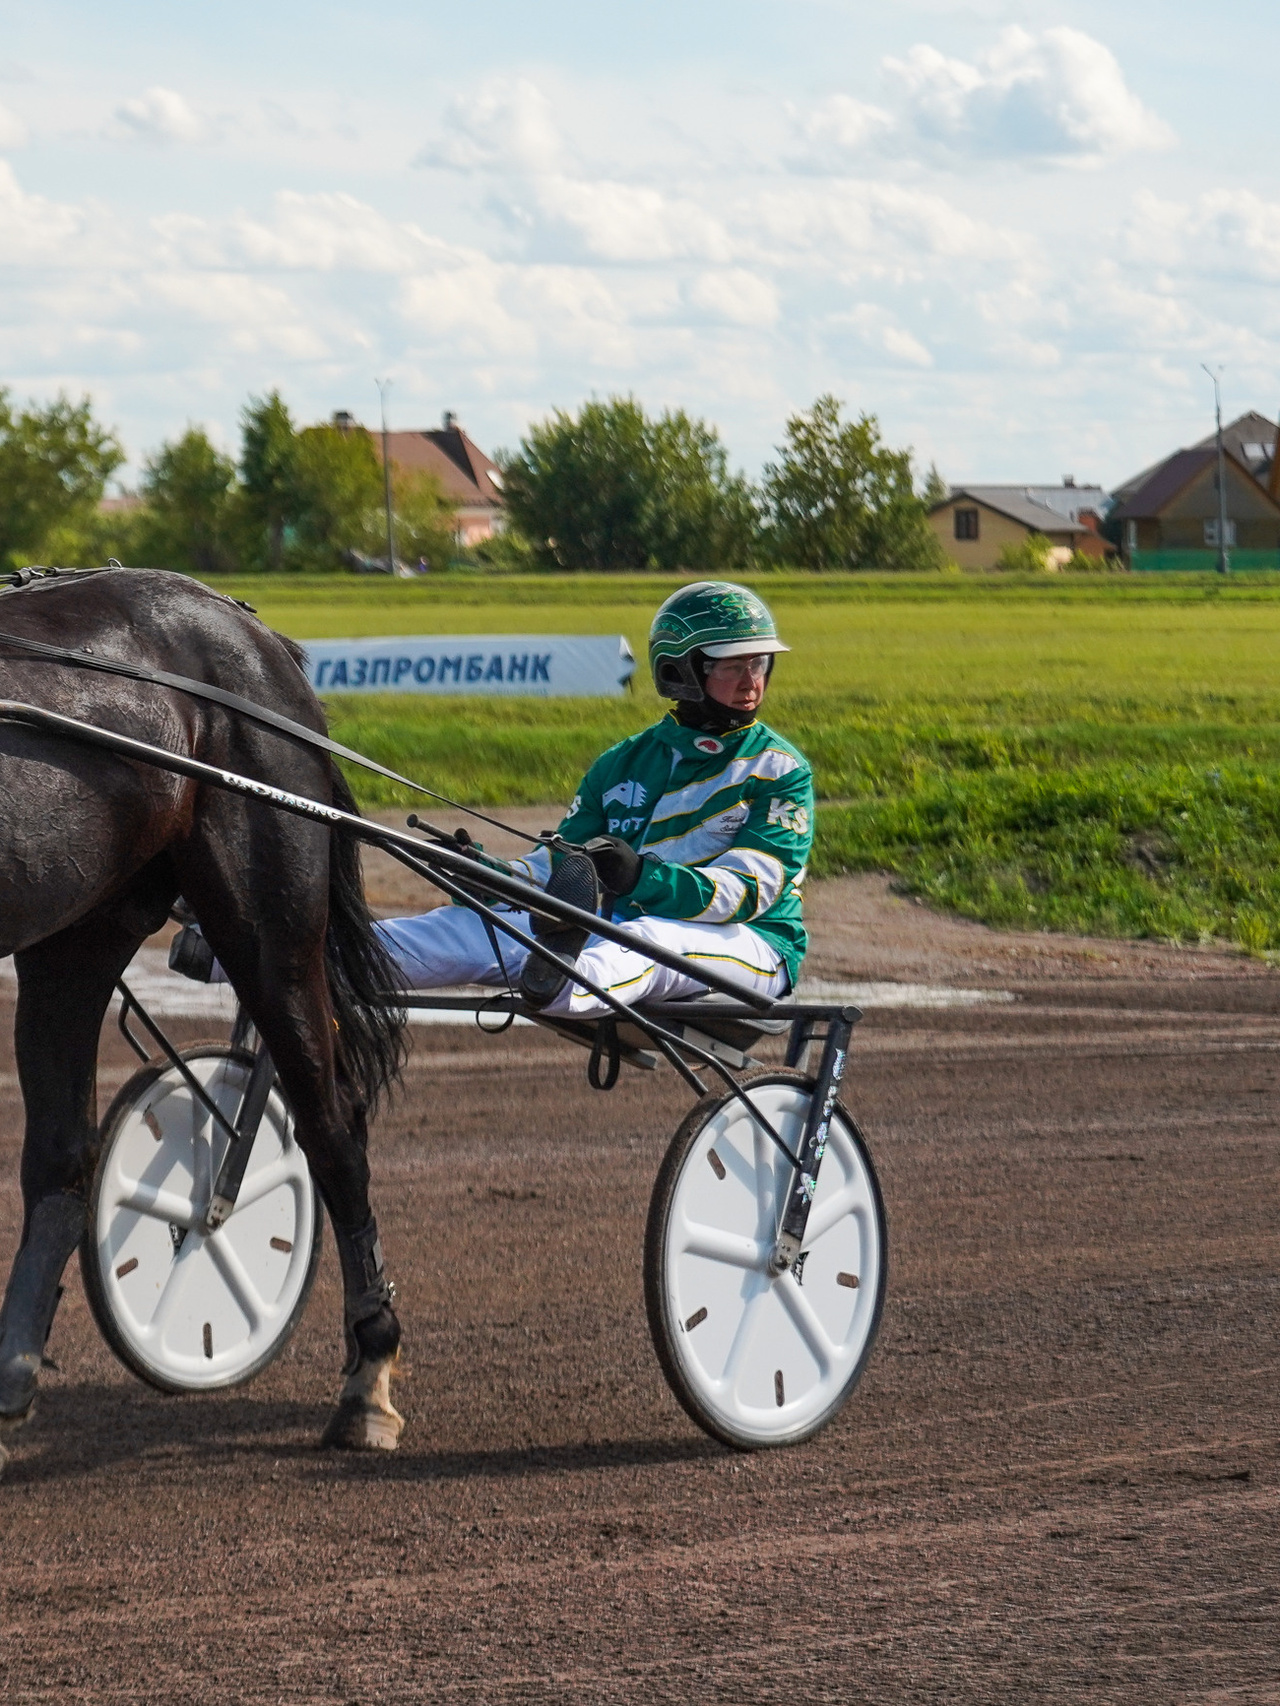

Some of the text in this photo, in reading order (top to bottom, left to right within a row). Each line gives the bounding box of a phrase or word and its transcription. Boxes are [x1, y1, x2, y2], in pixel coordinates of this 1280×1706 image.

[315, 653, 552, 688] ГАЗПРОМБАНК
[607, 816, 645, 834] POT
[766, 797, 809, 835] KS
